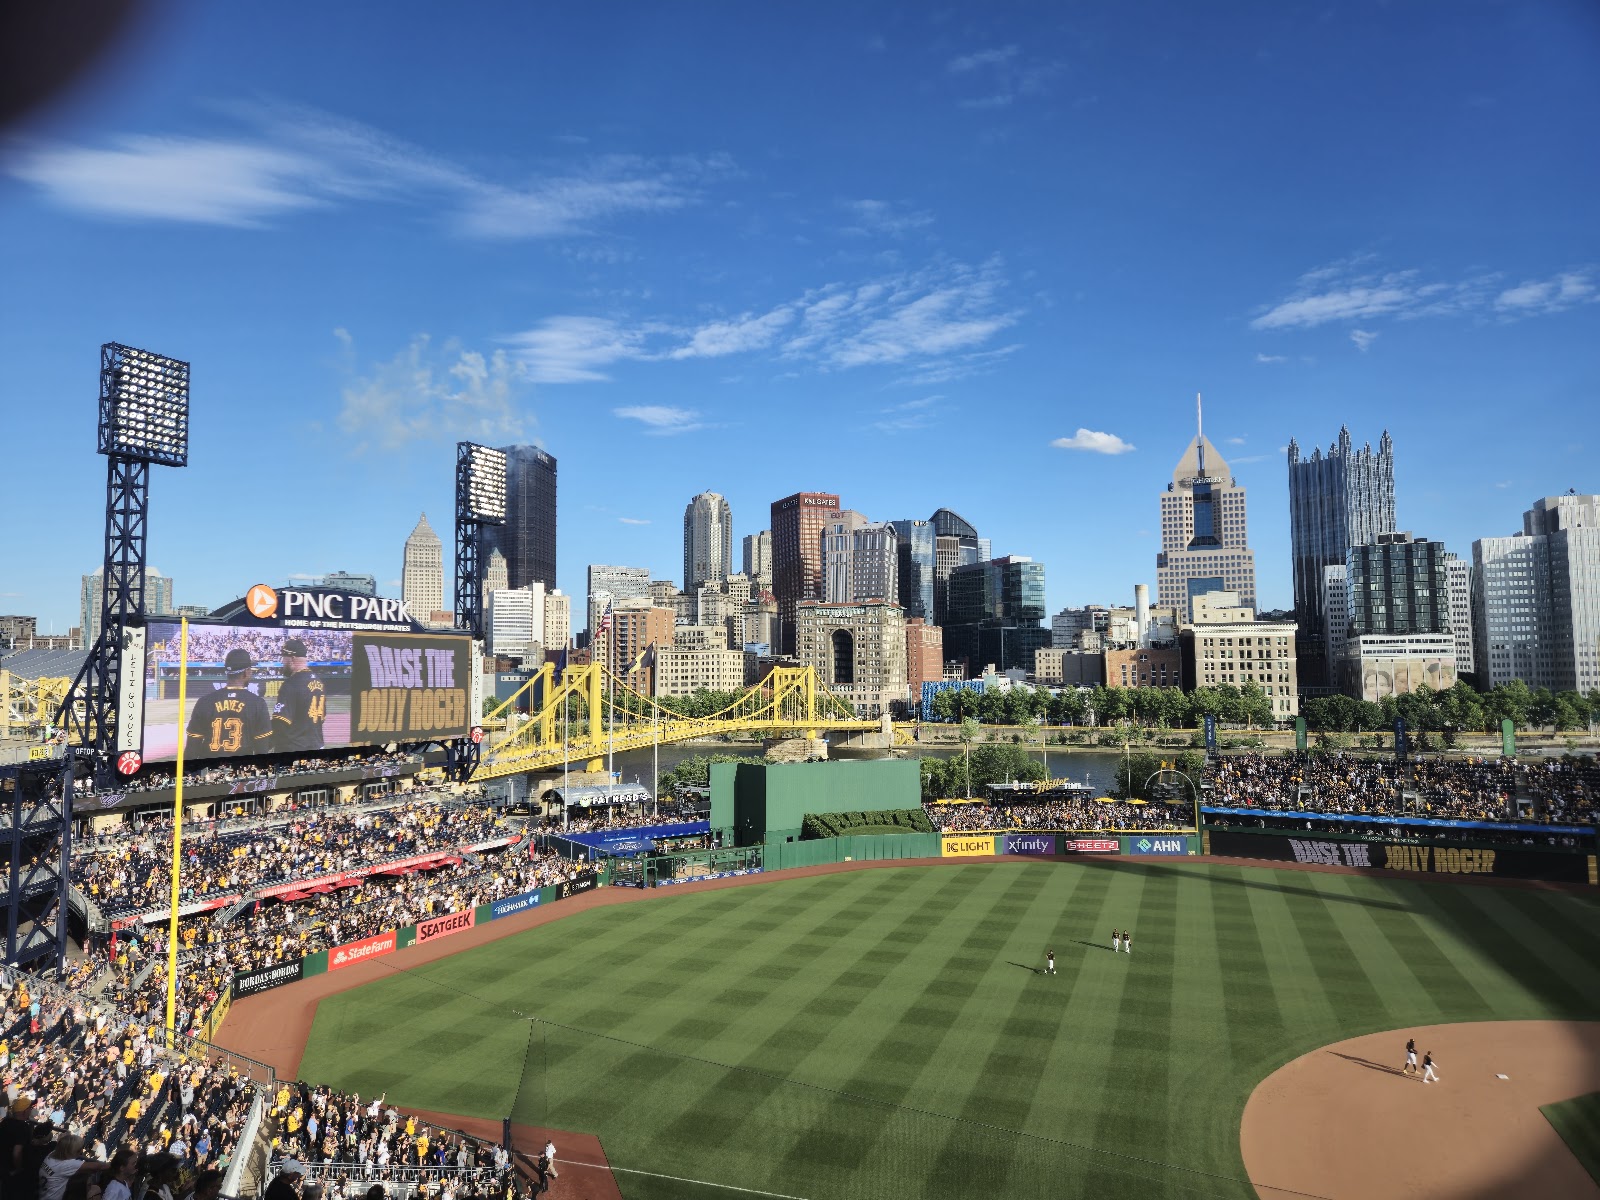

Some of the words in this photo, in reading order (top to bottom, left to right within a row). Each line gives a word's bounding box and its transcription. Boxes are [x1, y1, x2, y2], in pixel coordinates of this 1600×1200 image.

[817, 498, 836, 506] GATES
[282, 590, 343, 619] PNC
[348, 595, 412, 623] PARK
[284, 619, 309, 627] HOME
[309, 620, 321, 628] OF
[322, 621, 338, 629] THE
[338, 621, 382, 631] PITTSBURGH
[383, 624, 411, 632] PIRATES
[364, 645, 424, 689] RAISE
[424, 648, 455, 688] THE
[214, 699, 245, 714] HAYES
[358, 688, 408, 732] JOLLY
[409, 688, 466, 731] ROGER
[209, 717, 243, 752] 13
[592, 796, 610, 805] FAT
[960, 841, 990, 852] LIGHT
[1008, 838, 1049, 853] xfinity
[1069, 841, 1116, 850] SHEETZ
[1152, 840, 1181, 852] AHN
[1288, 838, 1342, 866] RAISE
[1341, 843, 1372, 867] THE
[1384, 845, 1430, 872] JOLLY
[1434, 847, 1496, 874] ROGER
[420, 911, 472, 940] SEATGEEK
[347, 942, 371, 961] State
[371, 938, 393, 954] Farm
[239, 971, 269, 990] BORDAS
[271, 963, 300, 980] BORDAS
